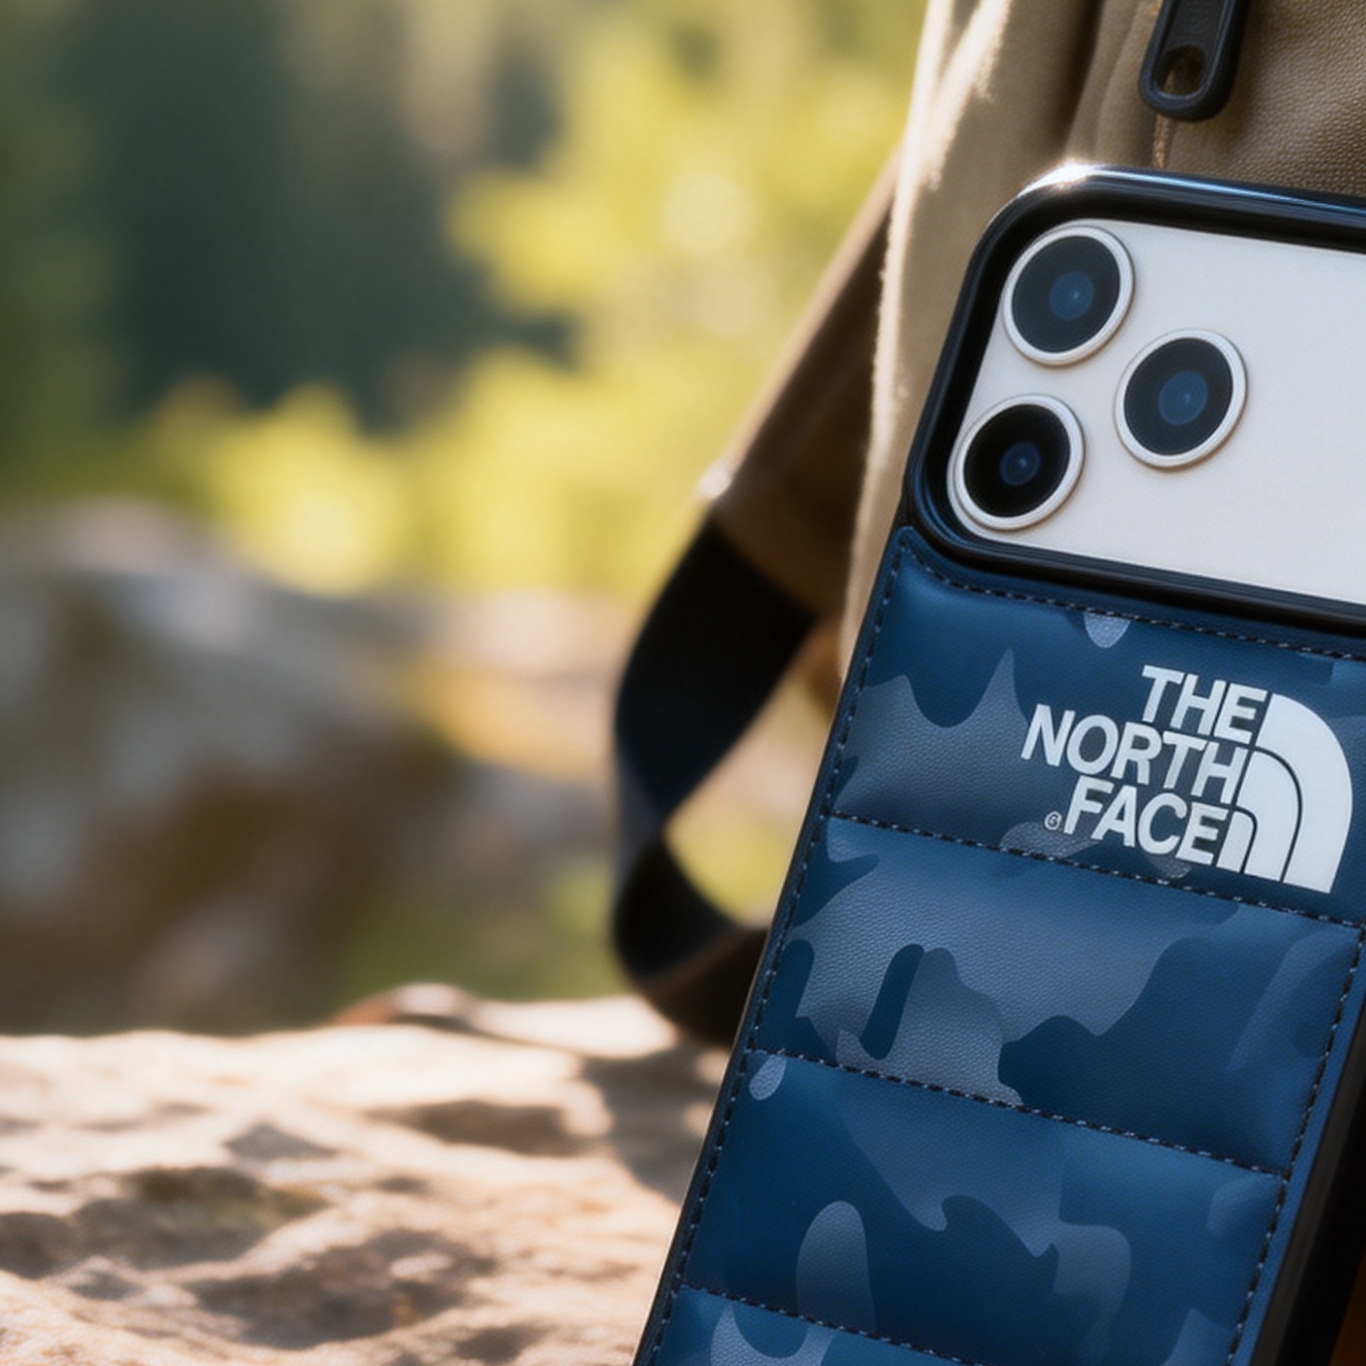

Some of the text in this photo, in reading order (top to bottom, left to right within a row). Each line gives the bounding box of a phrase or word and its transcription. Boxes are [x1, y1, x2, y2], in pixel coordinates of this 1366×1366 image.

[1141, 664, 1268, 745] THE
[1021, 703, 1249, 804] NORTH
[1064, 775, 1228, 866] FACE
